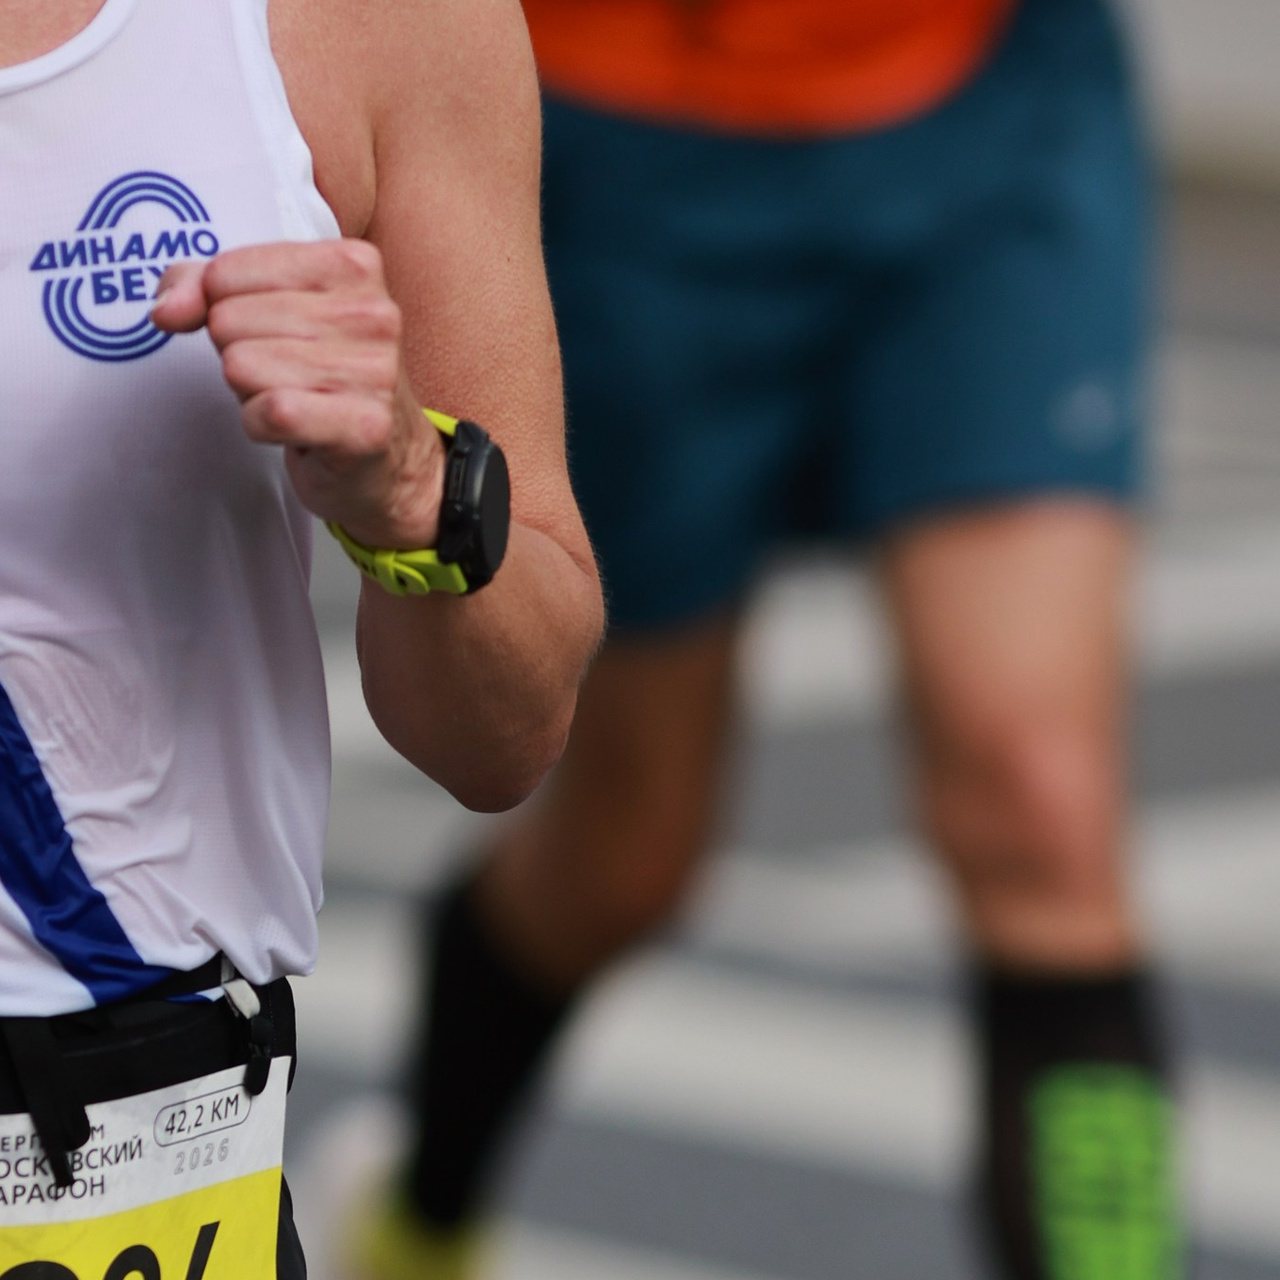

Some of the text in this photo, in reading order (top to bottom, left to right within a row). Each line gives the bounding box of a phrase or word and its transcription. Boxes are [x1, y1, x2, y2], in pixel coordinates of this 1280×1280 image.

[29, 229, 219, 272] ДИНАМО
[164, 1104, 204, 1135] 42,2
[174, 1137, 229, 1175] 2026
